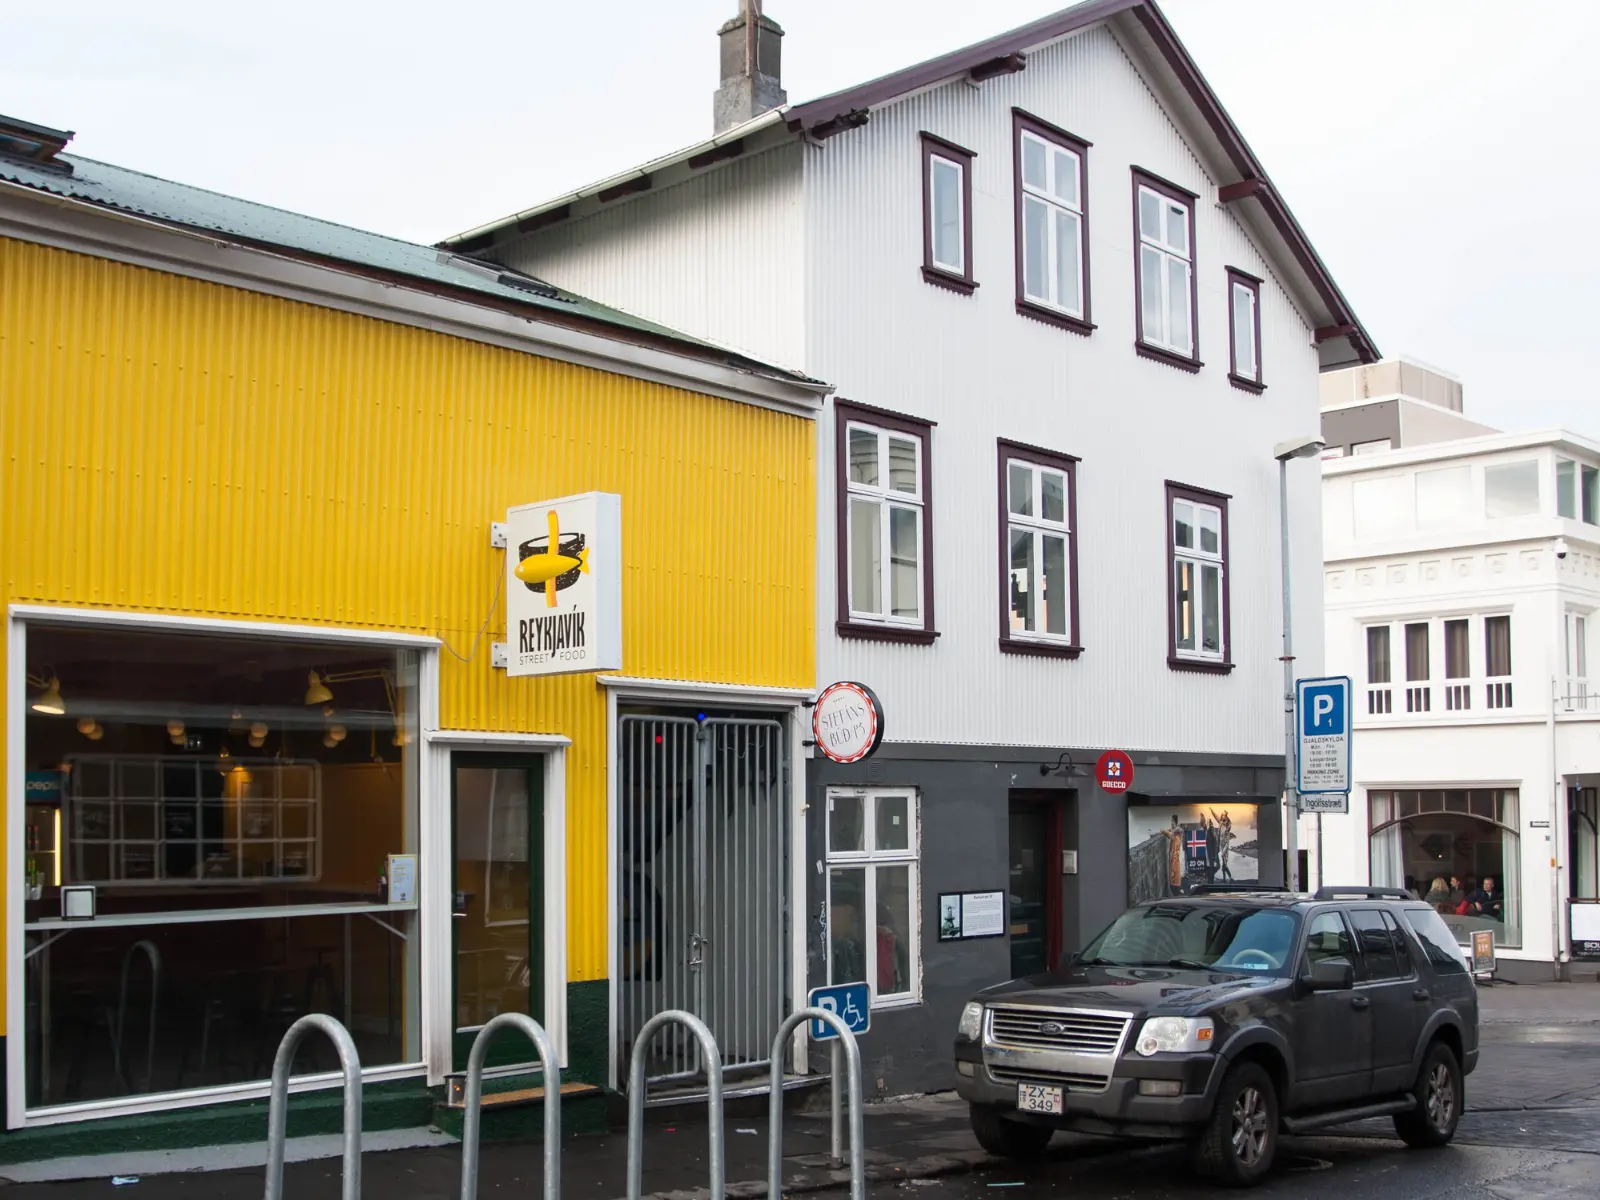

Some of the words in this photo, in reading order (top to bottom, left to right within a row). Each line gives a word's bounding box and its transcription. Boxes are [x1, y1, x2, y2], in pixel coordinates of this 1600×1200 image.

[519, 604, 585, 659] REYKJAVÍK
[519, 653, 549, 665] STREET
[559, 649, 586, 661] FOOD
[1028, 1098, 1053, 1111] 349
